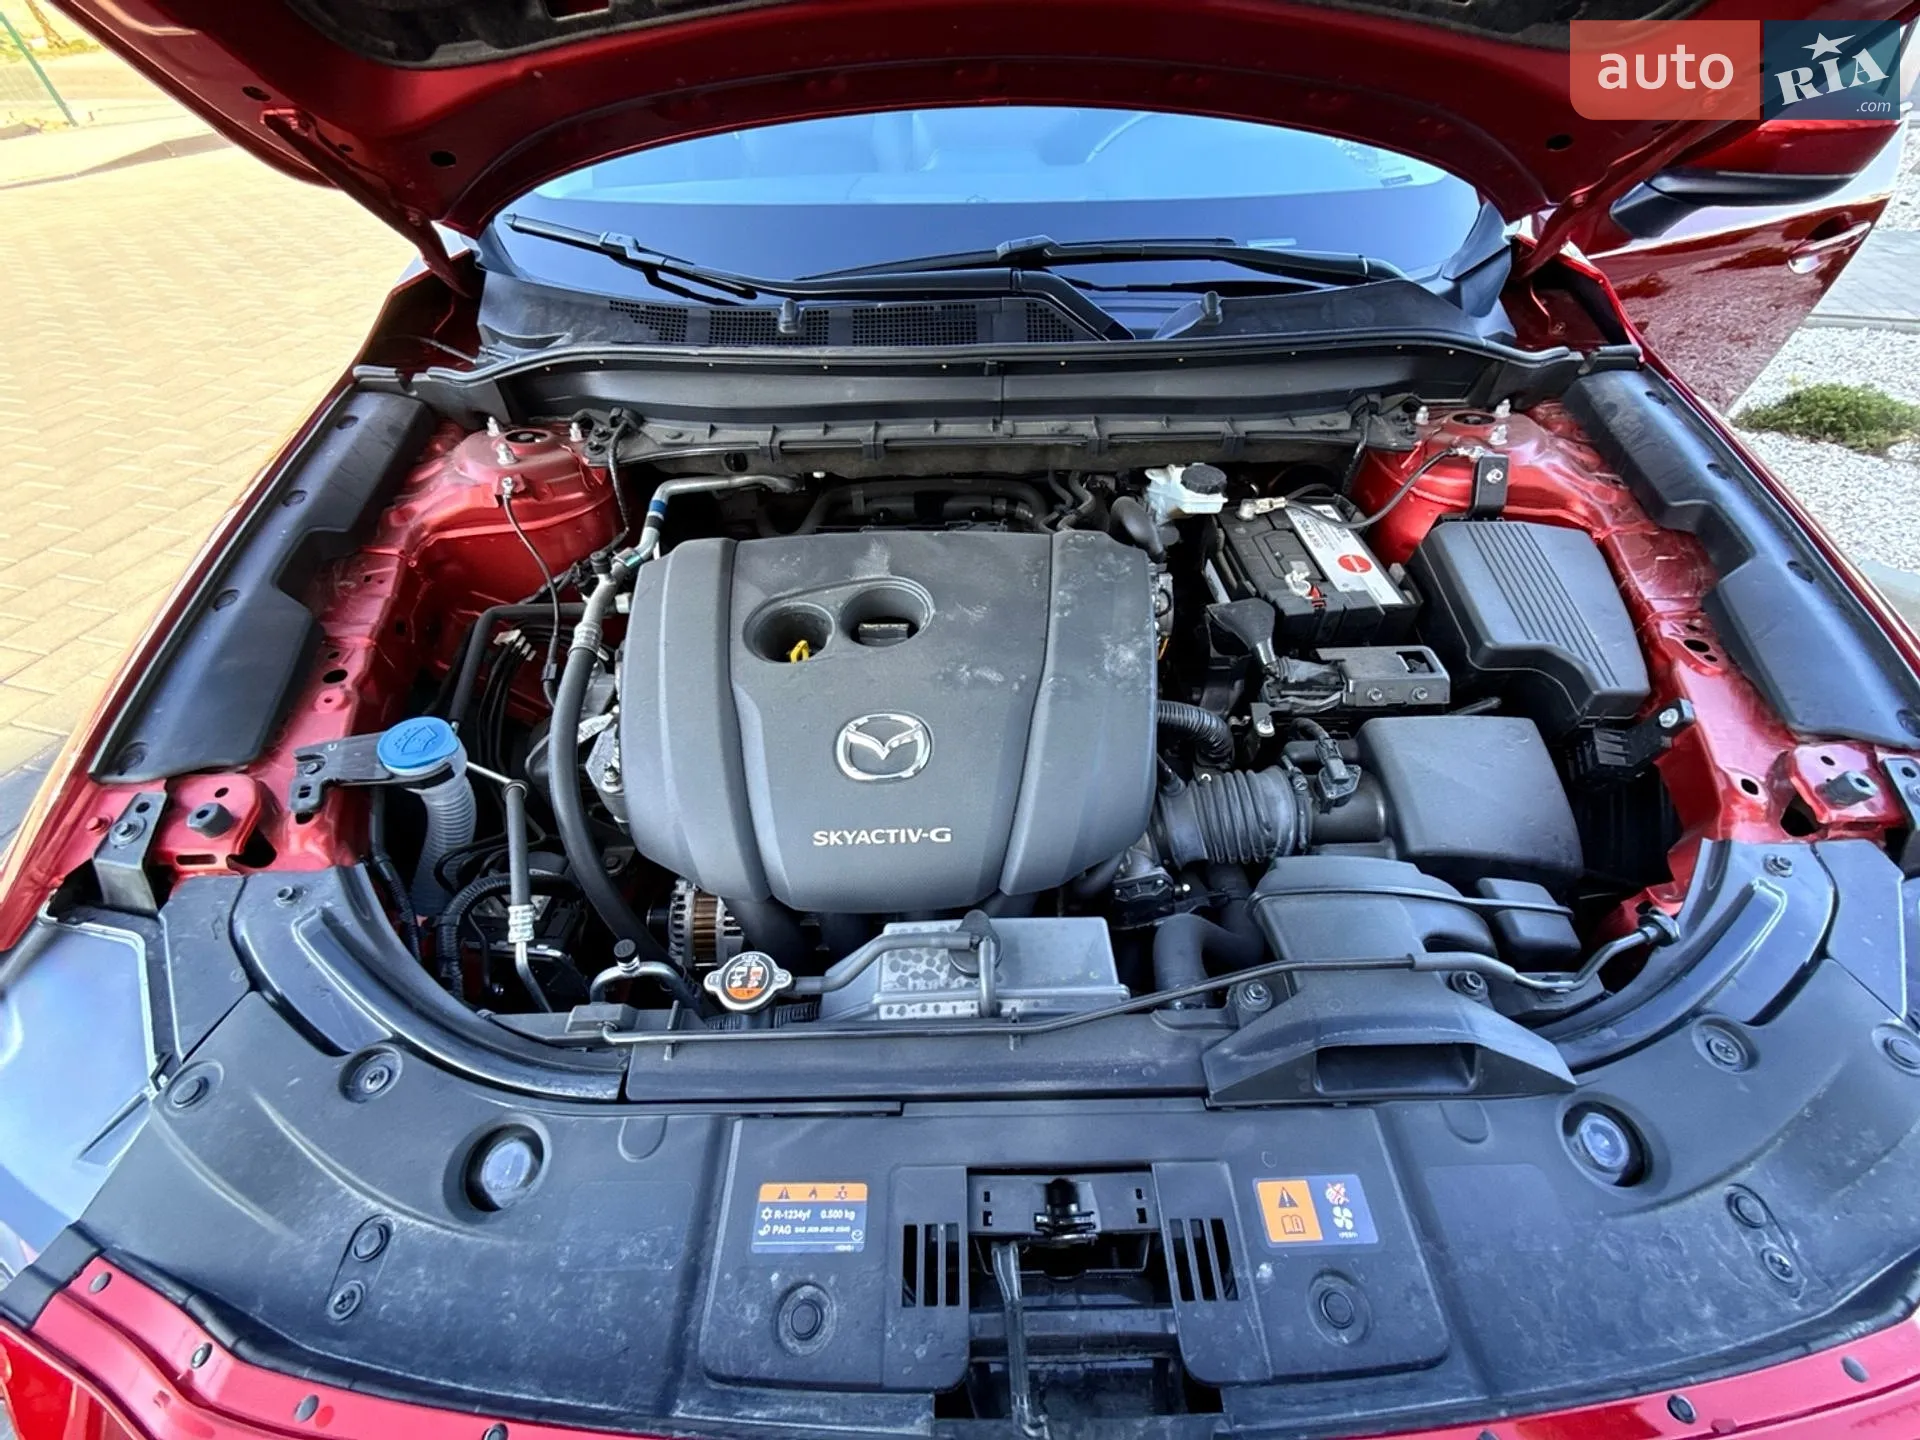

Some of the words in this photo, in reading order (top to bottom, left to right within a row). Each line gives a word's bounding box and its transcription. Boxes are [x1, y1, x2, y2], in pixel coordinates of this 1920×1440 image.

[813, 827, 952, 846] SKYACTIV-G
[774, 1209, 812, 1221] R-1234yf
[844, 1209, 856, 1221] kg
[772, 1225, 792, 1235] PAG
